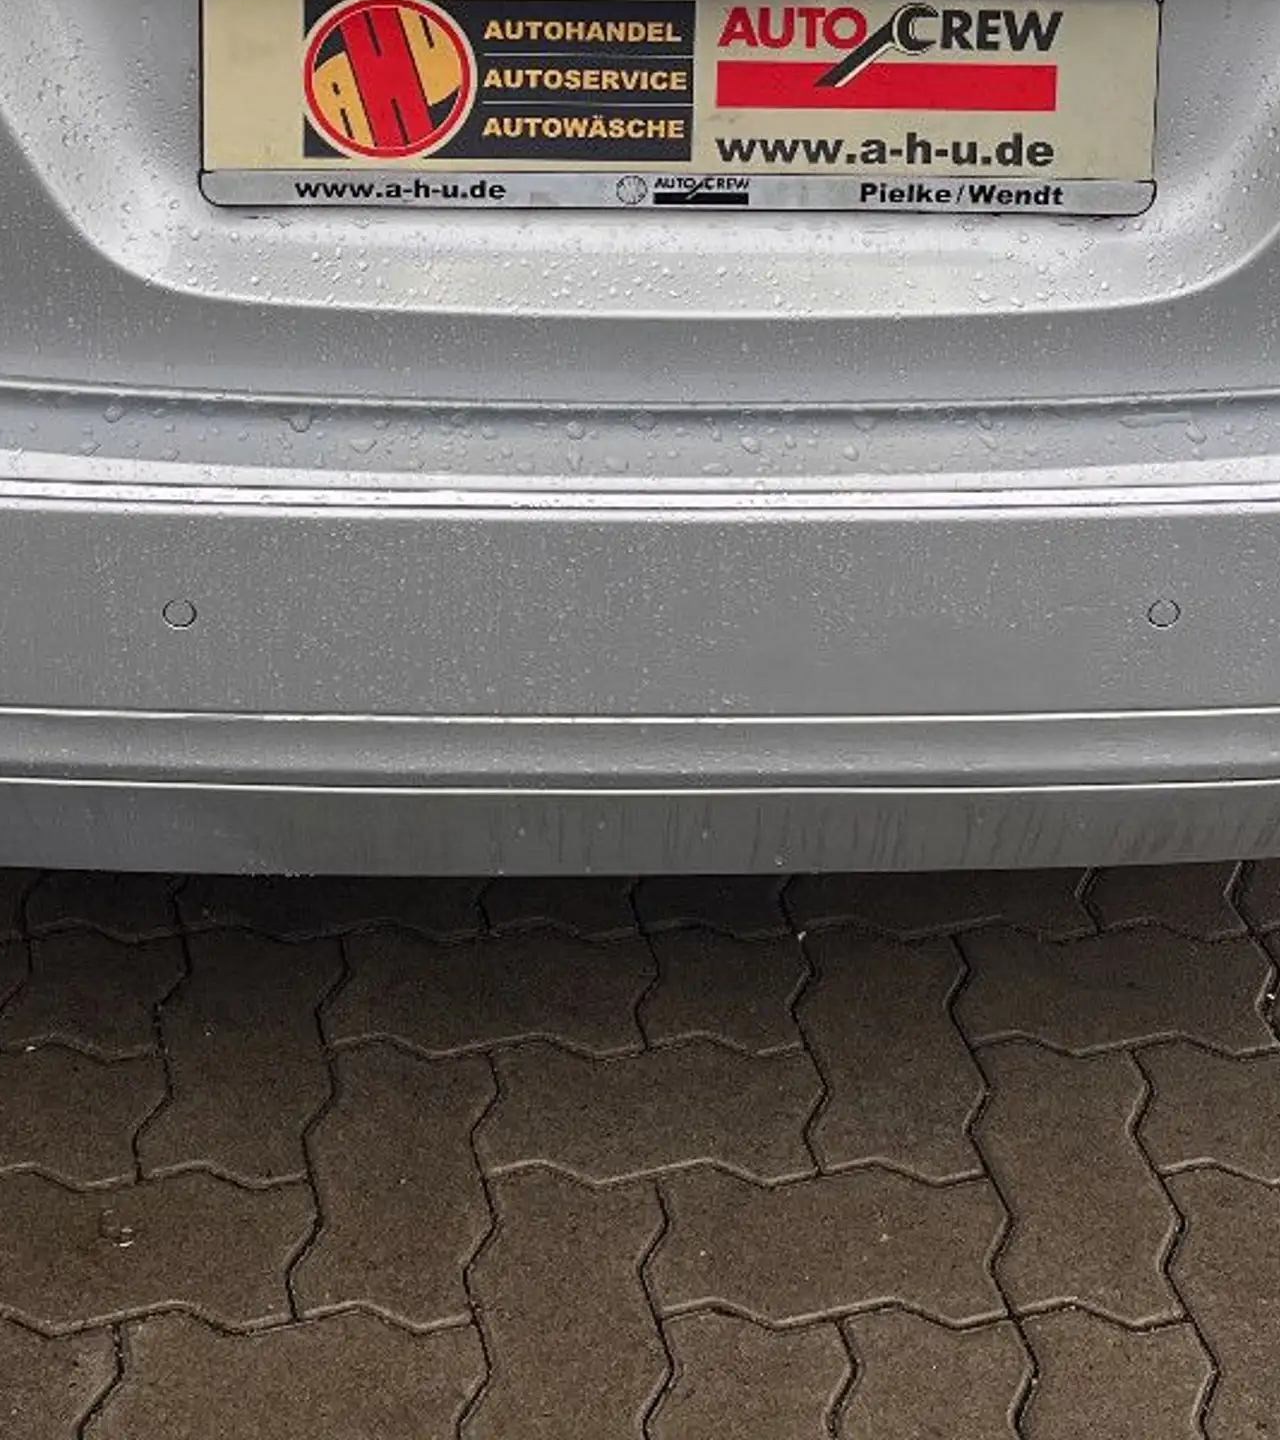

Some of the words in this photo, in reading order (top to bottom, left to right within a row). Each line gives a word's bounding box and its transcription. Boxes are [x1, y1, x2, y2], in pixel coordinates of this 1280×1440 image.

[483, 19, 683, 43] AUTOHANDEL
[717, 6, 868, 49] AUTO
[894, 3, 1064, 54] CREW
[483, 68, 688, 91] AUTOSERVICE
[482, 114, 686, 140] AUTOWÄSCHE
[715, 131, 1056, 167] www.a-h-u.de
[294, 178, 508, 200] www.a-h-u.de
